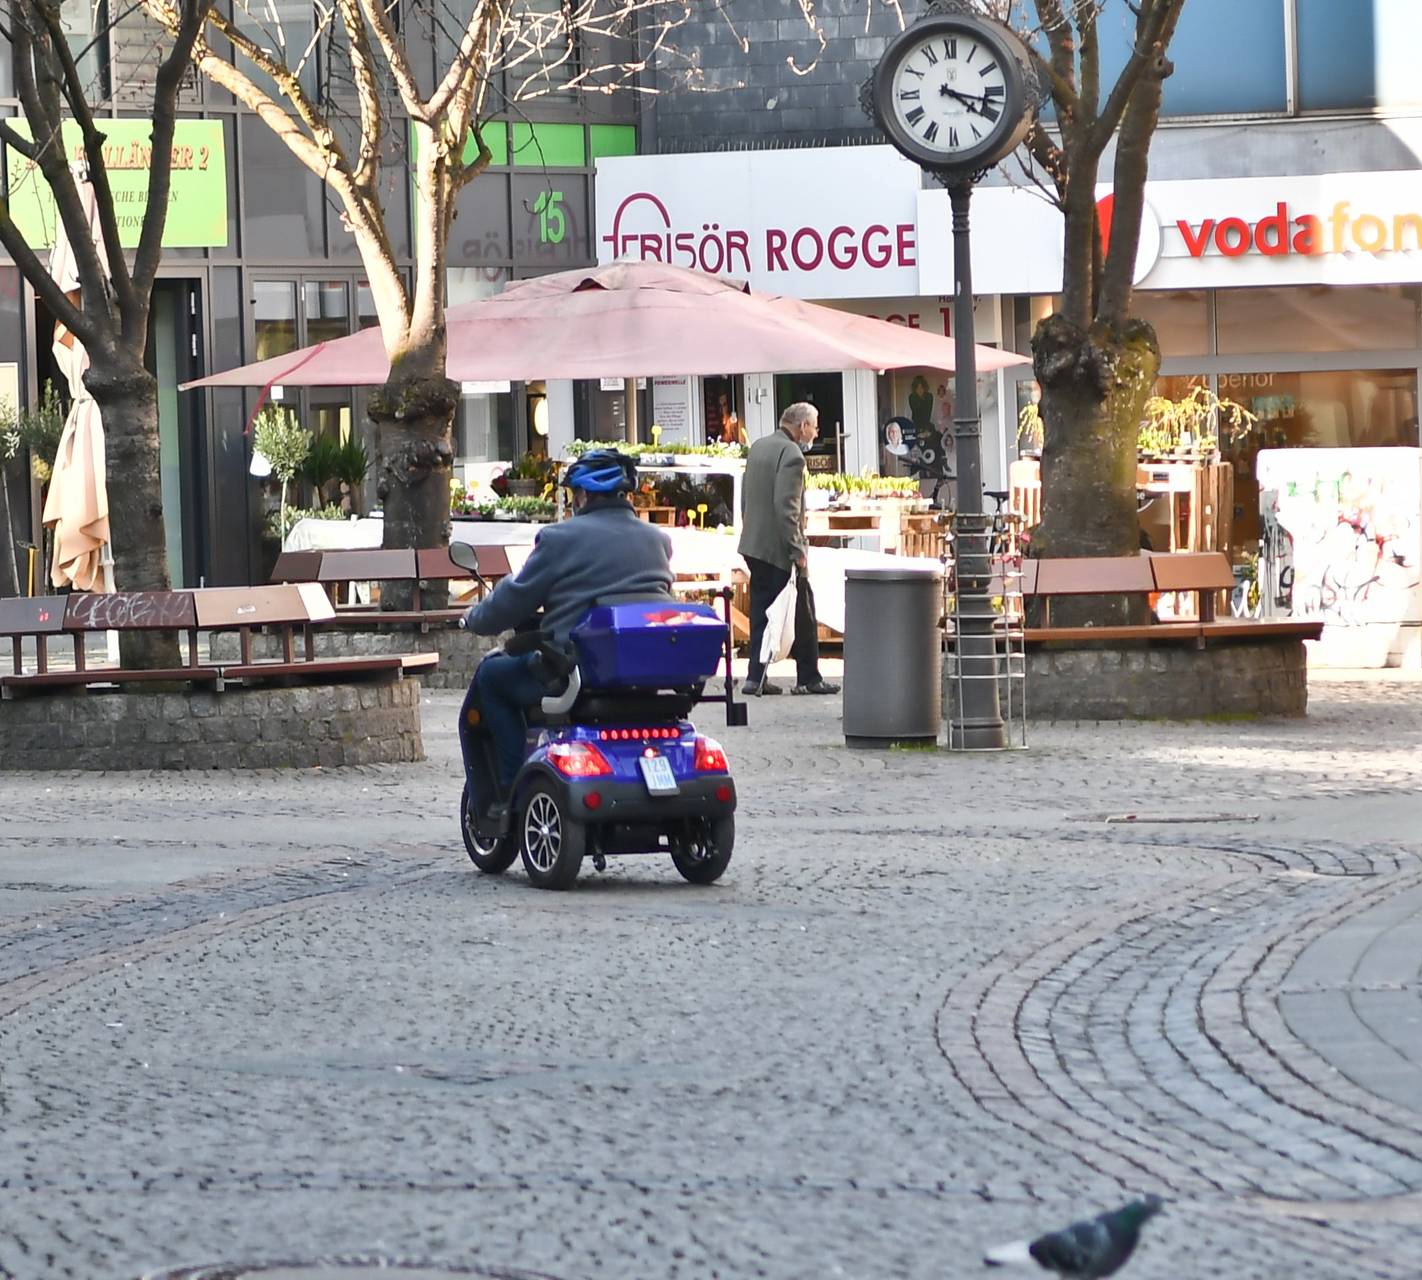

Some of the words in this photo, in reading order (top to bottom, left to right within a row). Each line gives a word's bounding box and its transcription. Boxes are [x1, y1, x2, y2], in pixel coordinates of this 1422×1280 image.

[199, 145, 209, 171] 2
[534, 191, 565, 244] 15
[766, 223, 916, 272] ROGGE
